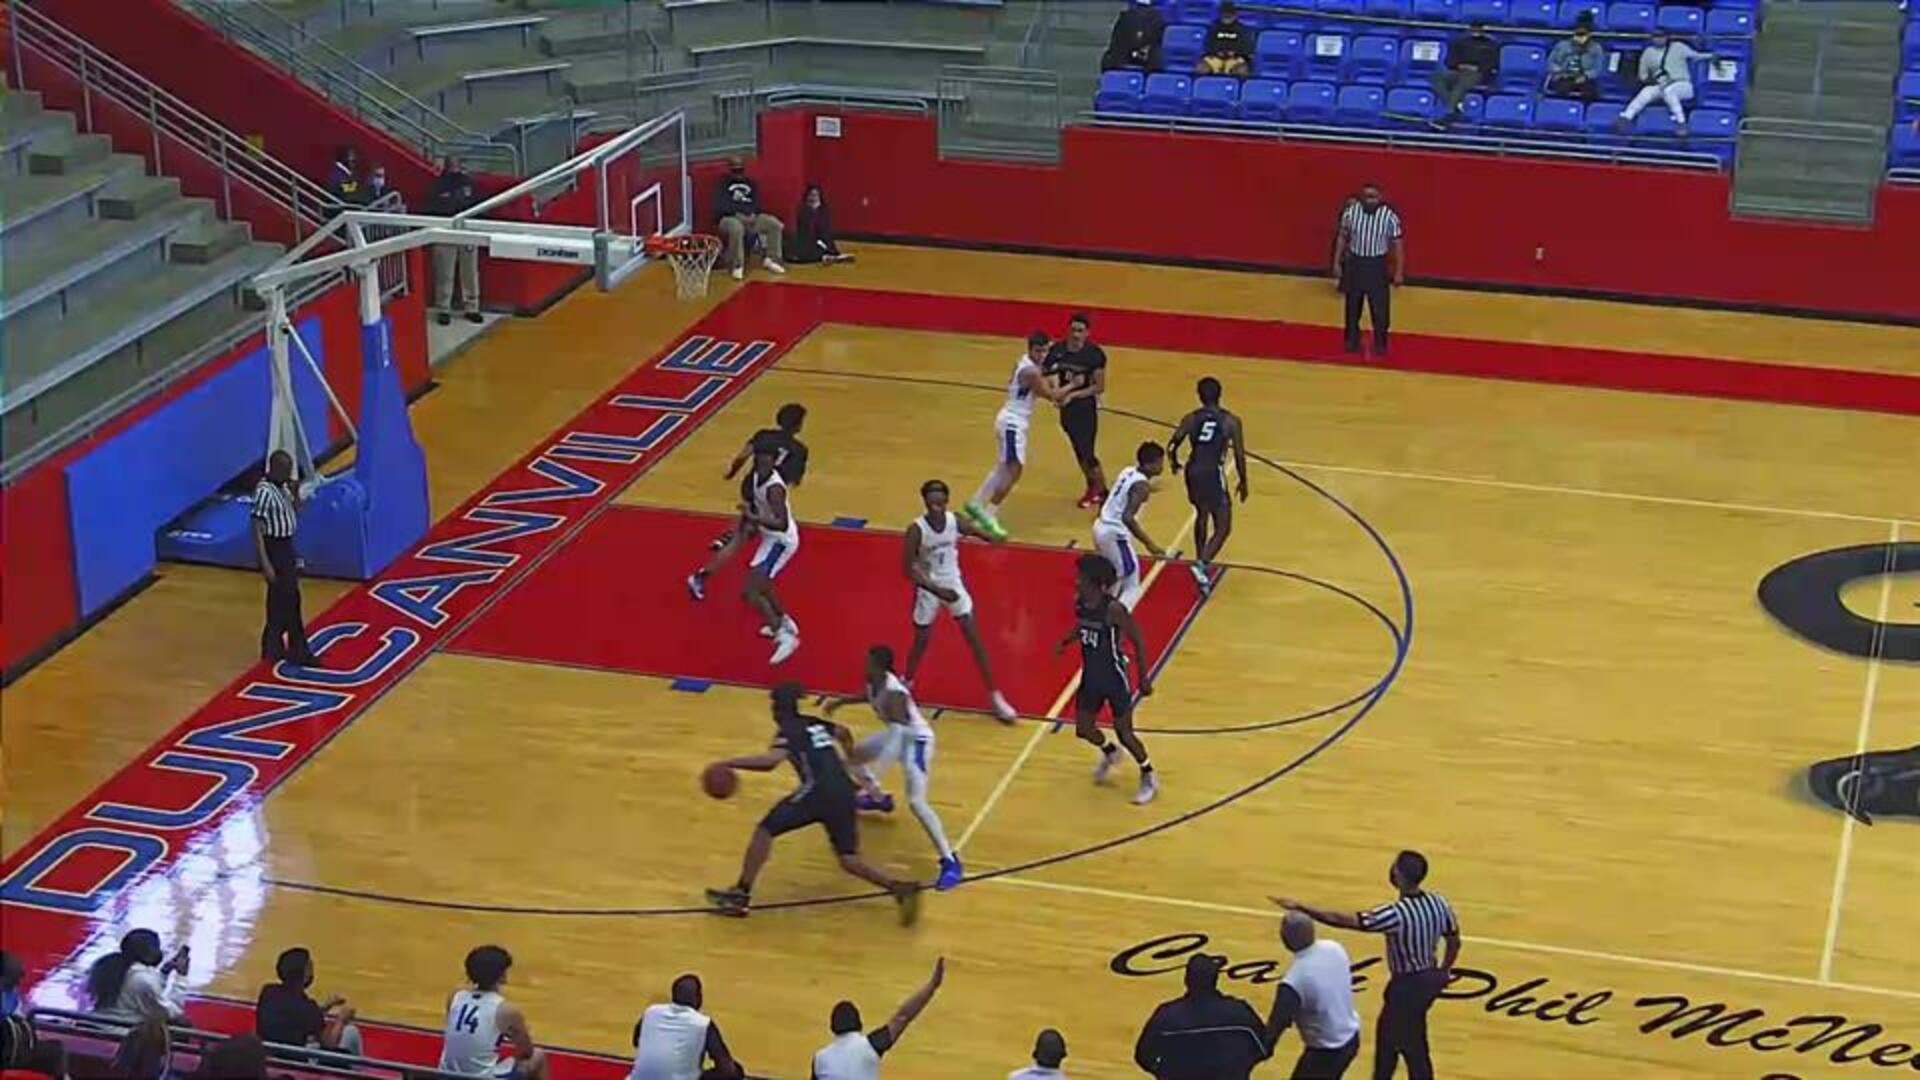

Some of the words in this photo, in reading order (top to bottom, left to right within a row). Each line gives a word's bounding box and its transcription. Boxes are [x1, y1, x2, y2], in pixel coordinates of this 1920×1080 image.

[1198, 421, 1217, 442] 5
[0, 335, 775, 922] DUNCANVILLE
[1436, 967, 1613, 1025] Phil
[456, 1004, 479, 1034] 14
